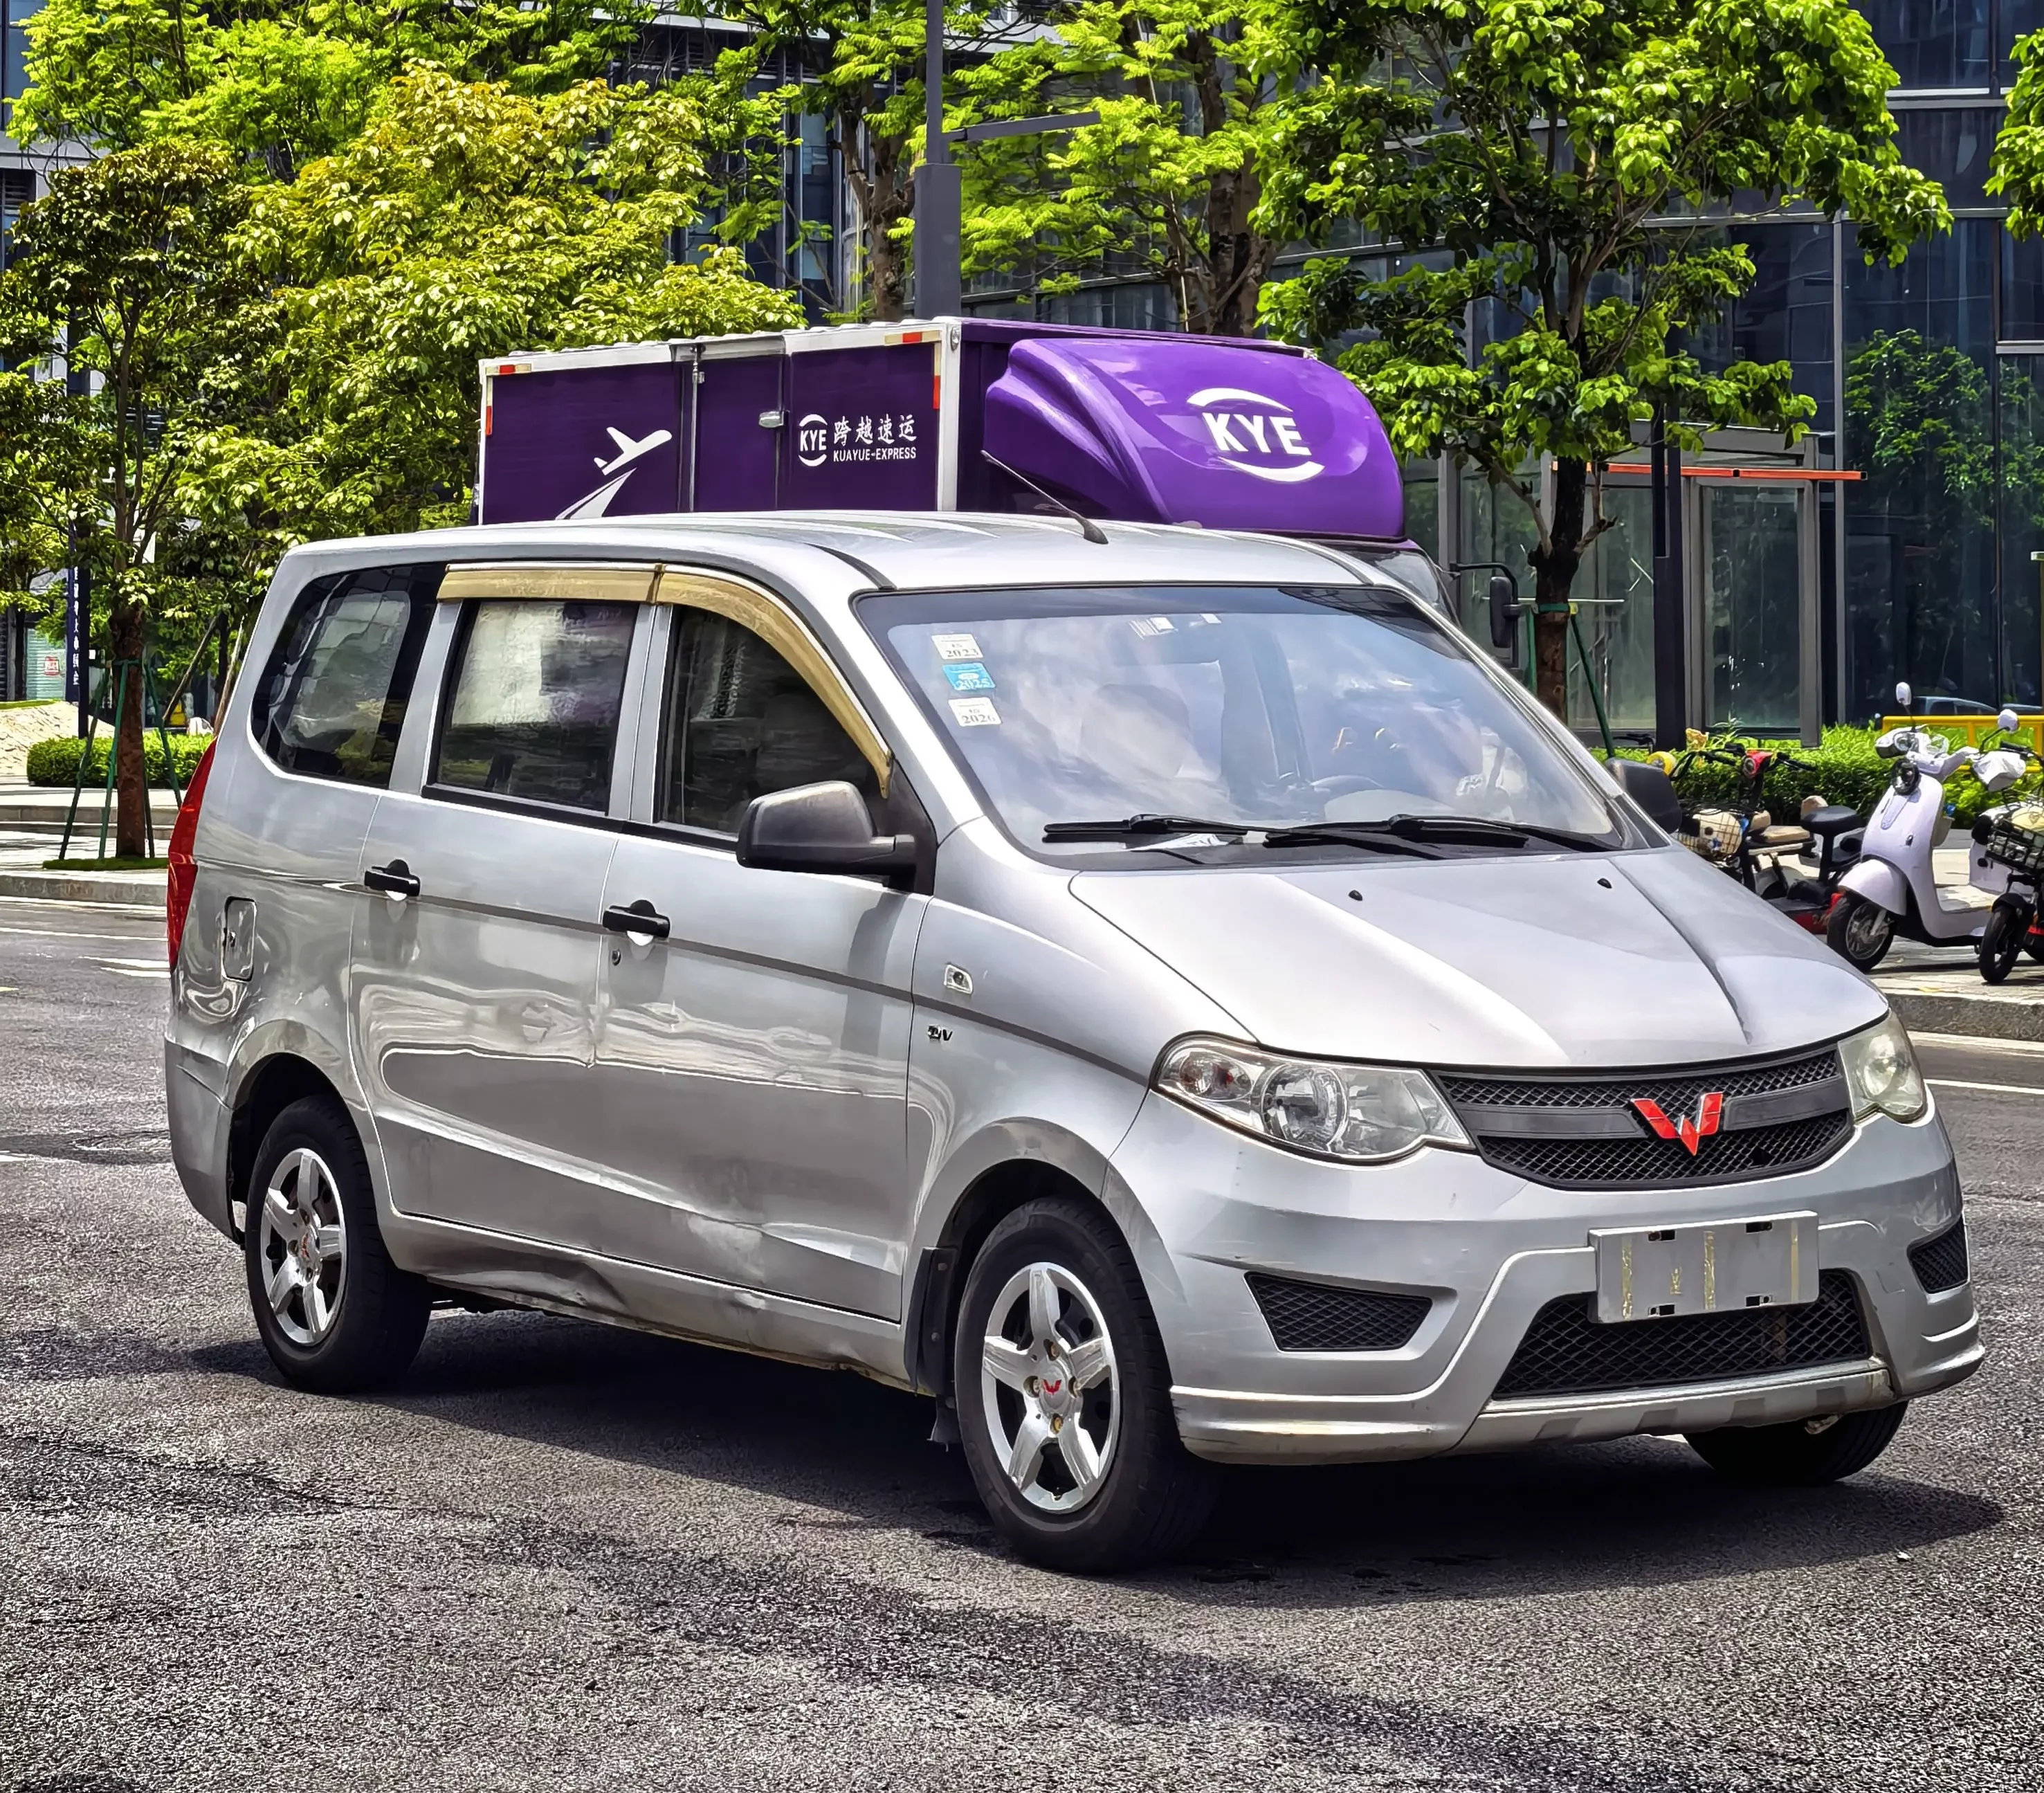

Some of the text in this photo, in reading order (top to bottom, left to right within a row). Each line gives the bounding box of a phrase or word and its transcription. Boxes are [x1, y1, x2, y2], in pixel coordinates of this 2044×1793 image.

[799, 429, 828, 451] KYE
[833, 413, 917, 447] 跨越速运
[1202, 412, 1312, 455] KYE
[832, 446, 917, 462] KUAYUE-EXPRESS
